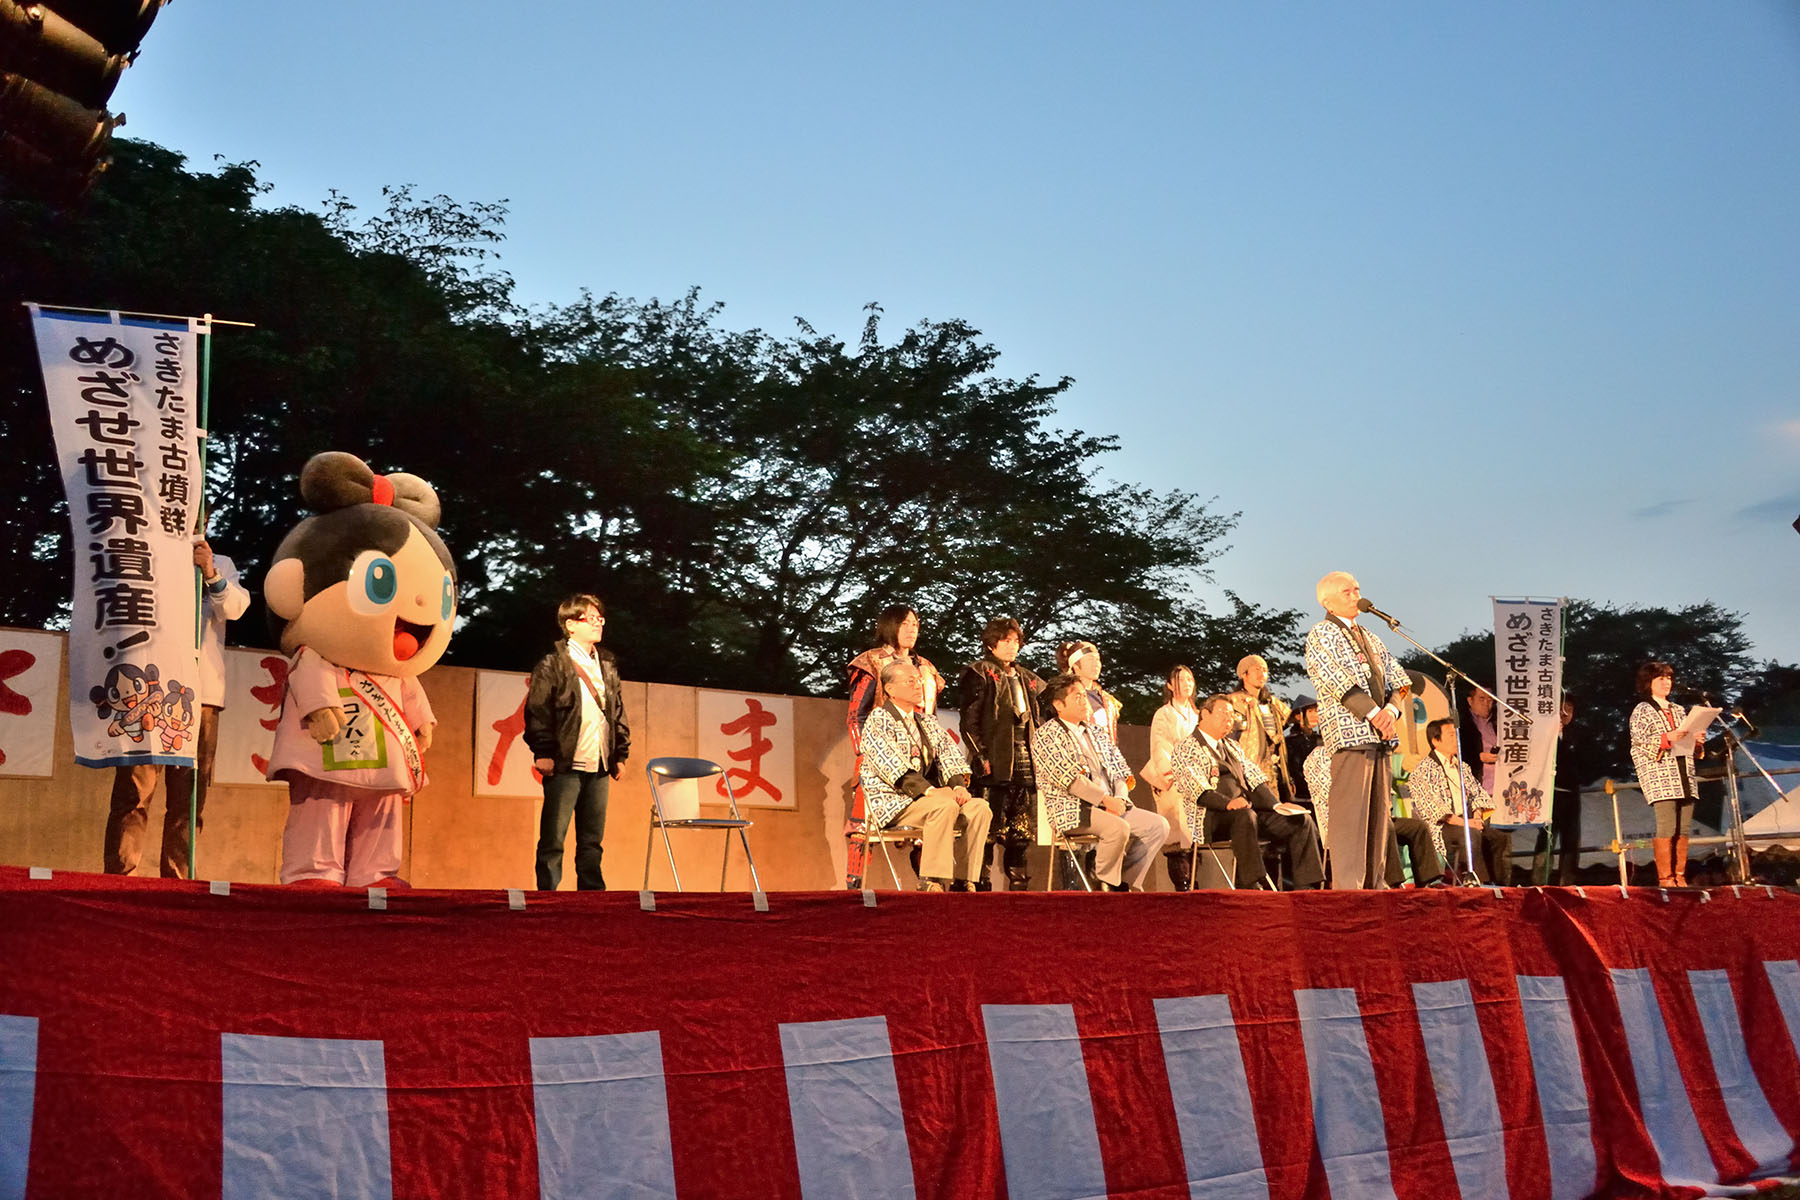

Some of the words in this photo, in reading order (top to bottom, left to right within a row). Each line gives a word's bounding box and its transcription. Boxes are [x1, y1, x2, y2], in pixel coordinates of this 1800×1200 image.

[69, 336, 156, 660] めざせ世界遺産!
[153, 332, 189, 536] さきたま古墳群
[1503, 612, 1532, 778] めざせ世界遺産!
[1537, 607, 1553, 714] さきたま古墳群
[716, 698, 782, 802] ま
